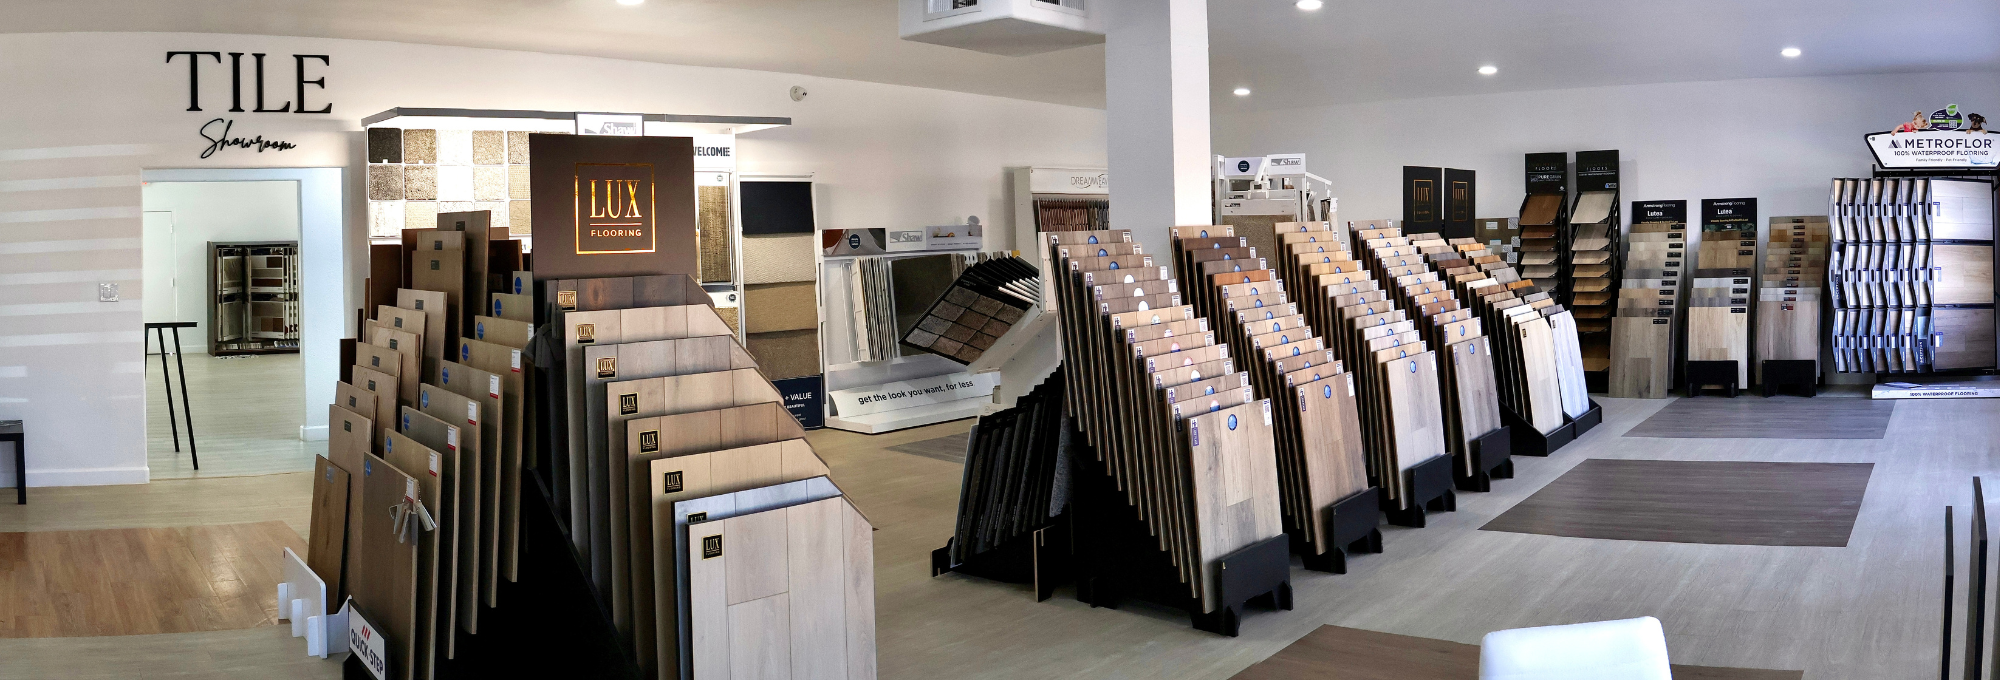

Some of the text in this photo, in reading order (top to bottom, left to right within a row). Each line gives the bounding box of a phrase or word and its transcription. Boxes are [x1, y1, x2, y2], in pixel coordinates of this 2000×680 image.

[166, 51, 333, 114] TILE
[603, 122, 636, 135] Shaw
[199, 117, 297, 160] Showroom
[1904, 138, 1993, 149] METROFLOR
[589, 179, 643, 219] LUX
[590, 229, 642, 238] FLOORING
[902, 232, 921, 242] Shaw
[600, 360, 615, 372] LUX
[790, 392, 812, 401] VALUE
[858, 380, 974, 405] get the look you want, for less
[622, 396, 636, 407] LUX
[642, 433, 656, 445] LUX
[667, 474, 681, 486] LUX
[705, 538, 720, 551] LUX
